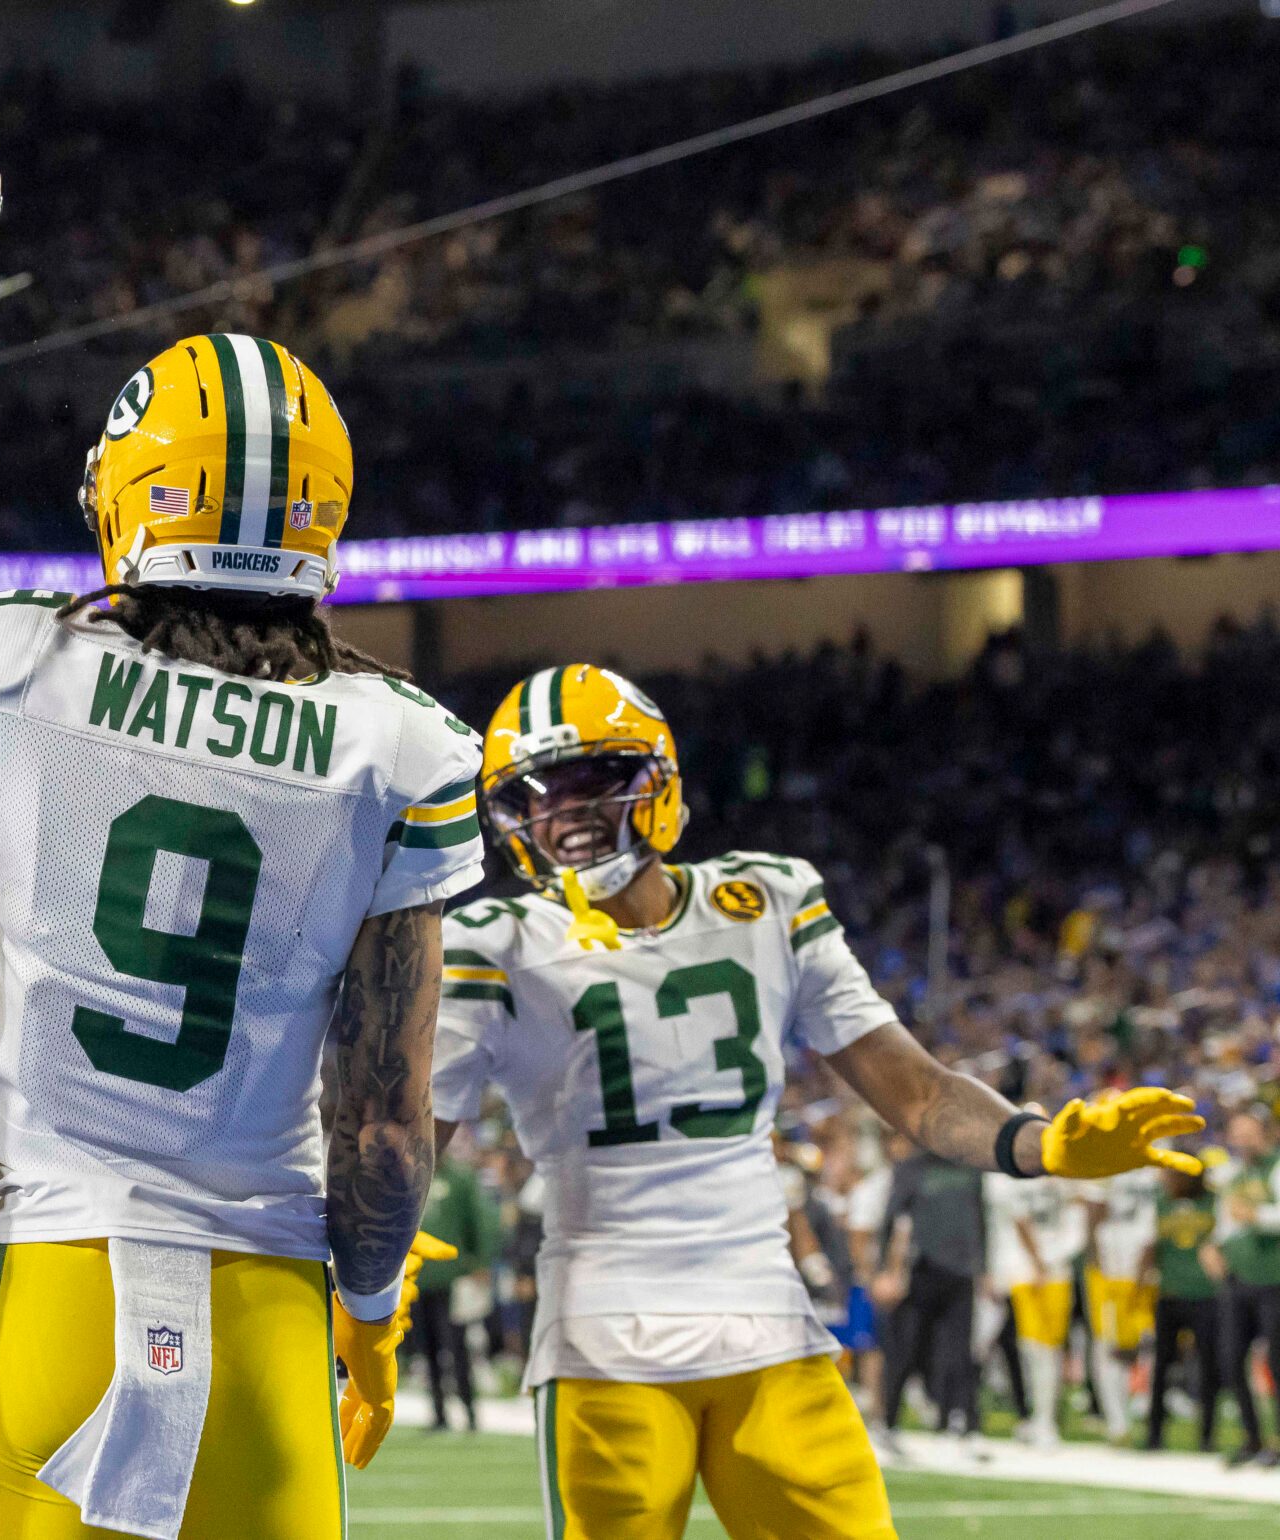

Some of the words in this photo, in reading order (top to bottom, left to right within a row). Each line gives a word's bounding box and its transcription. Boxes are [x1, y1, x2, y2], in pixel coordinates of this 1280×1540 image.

[212, 551, 281, 573] PACKERS
[88, 651, 338, 778] WATSON
[71, 793, 264, 1093] 9
[572, 957, 768, 1147] 13
[151, 1345, 179, 1369] NFL
